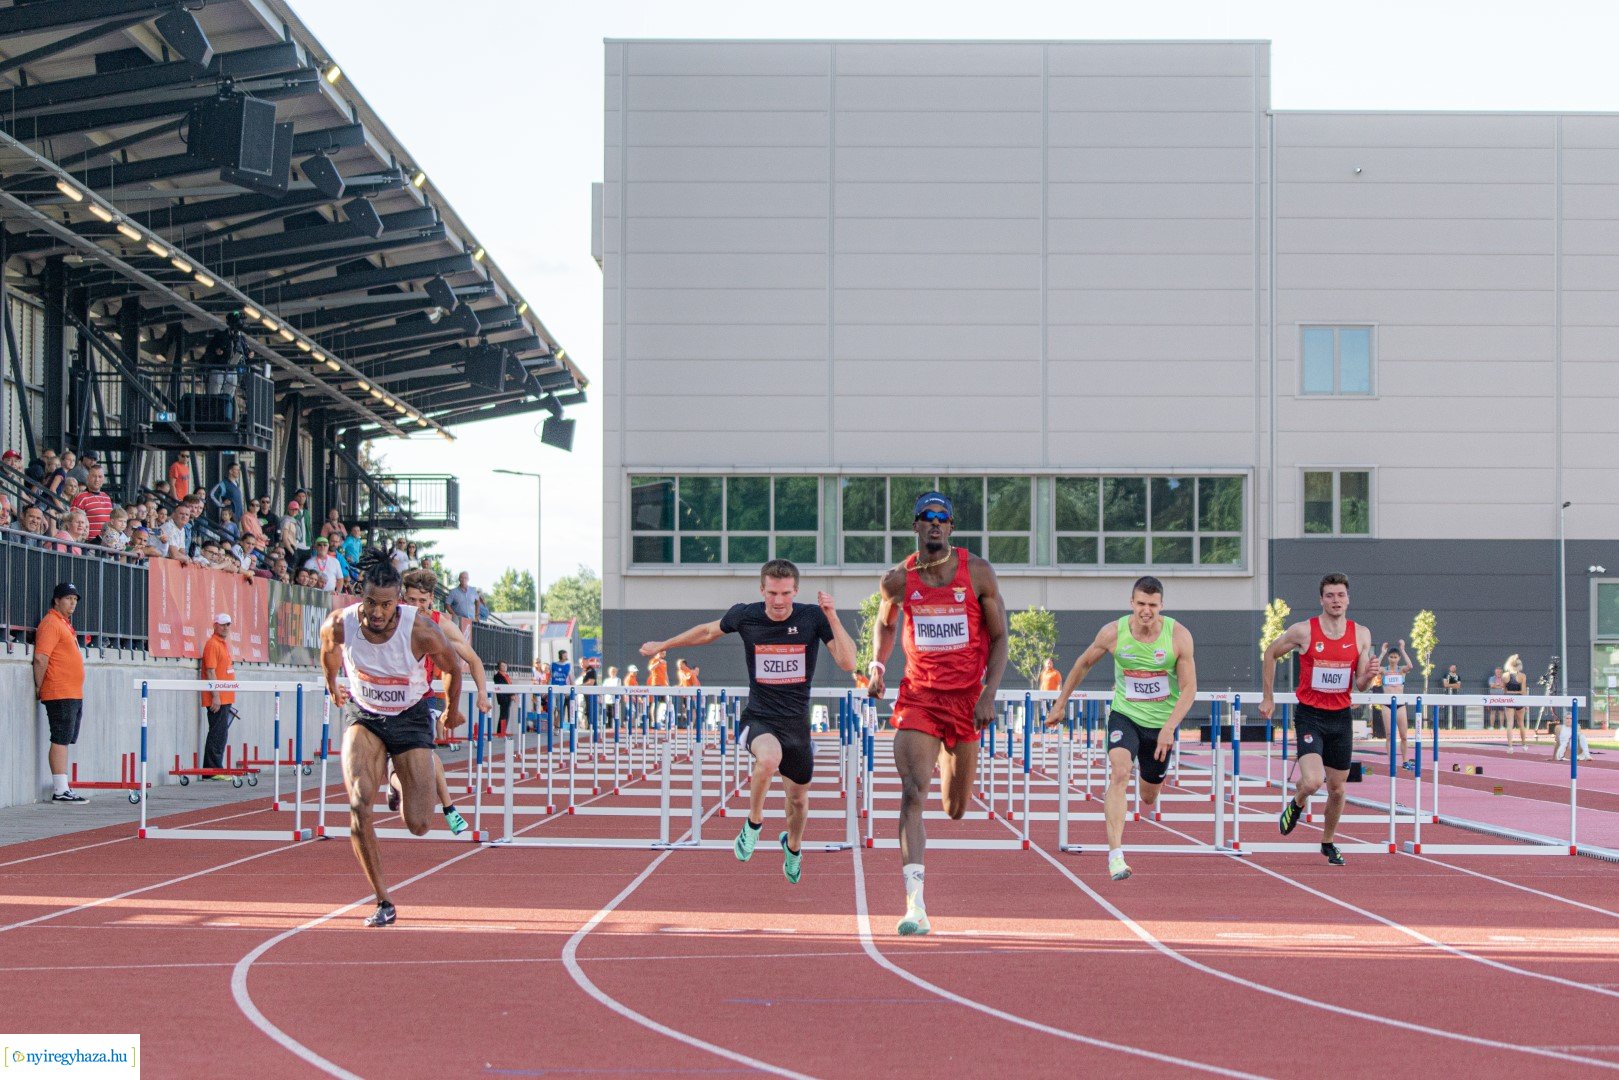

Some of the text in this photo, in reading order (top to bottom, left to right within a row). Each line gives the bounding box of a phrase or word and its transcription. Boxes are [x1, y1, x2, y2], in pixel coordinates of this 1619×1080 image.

[917, 622, 966, 638] IRIBARNE
[763, 659, 799, 673] SZELES
[1321, 672, 1343, 684] NAGY
[362, 685, 406, 702] DICKSON
[1133, 681, 1161, 694] ESZES
[1489, 696, 1515, 704] polanik
